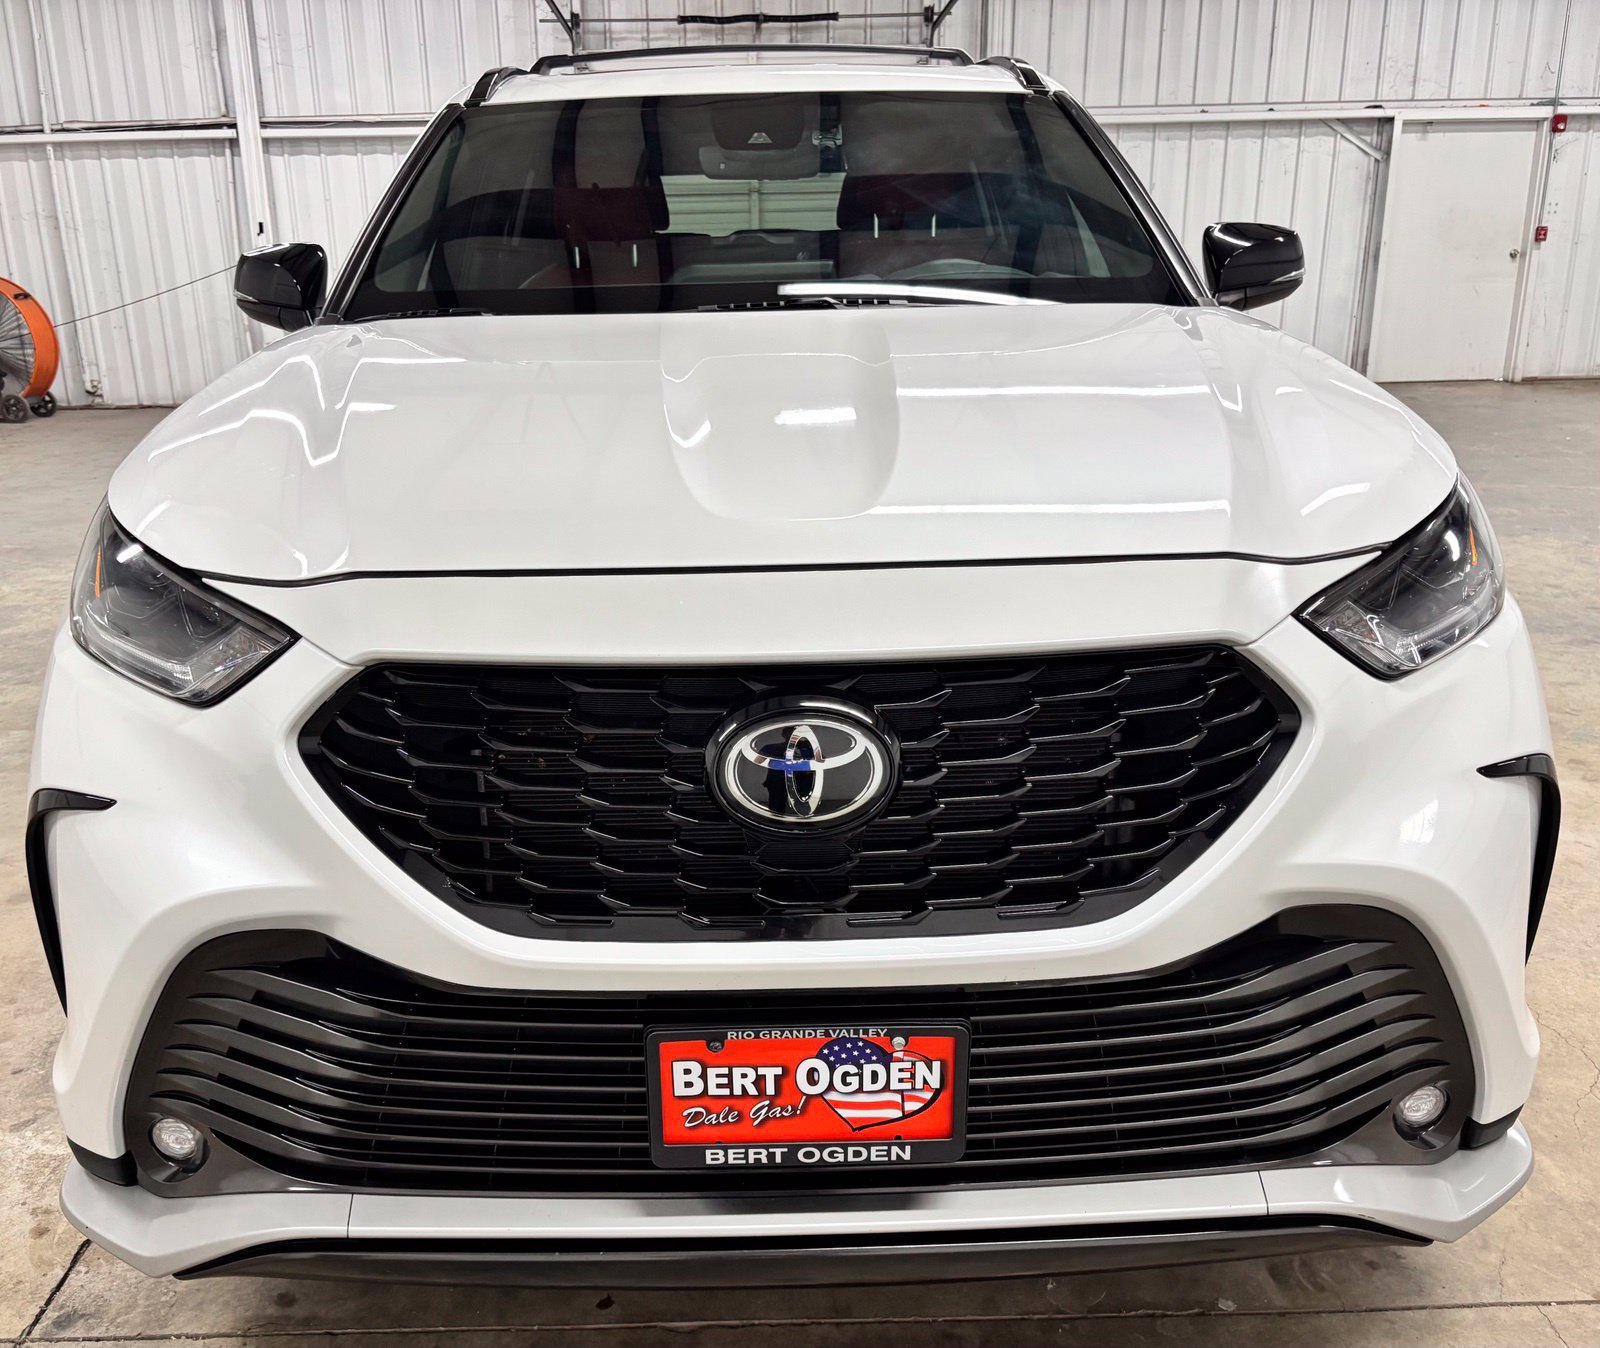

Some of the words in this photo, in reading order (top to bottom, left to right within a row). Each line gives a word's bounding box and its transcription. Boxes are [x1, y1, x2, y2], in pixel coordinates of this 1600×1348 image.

[727, 1030, 755, 1040] RIO
[760, 1029, 826, 1040] GRANDE
[829, 1028, 888, 1039] VALLEY
[671, 1059, 783, 1097] BERT
[795, 1057, 941, 1096] OGDEN
[682, 1104, 739, 1128] Dale
[749, 1095, 807, 1126] Gas!
[705, 1147, 788, 1165] BERT
[797, 1145, 911, 1164] OGDEN
